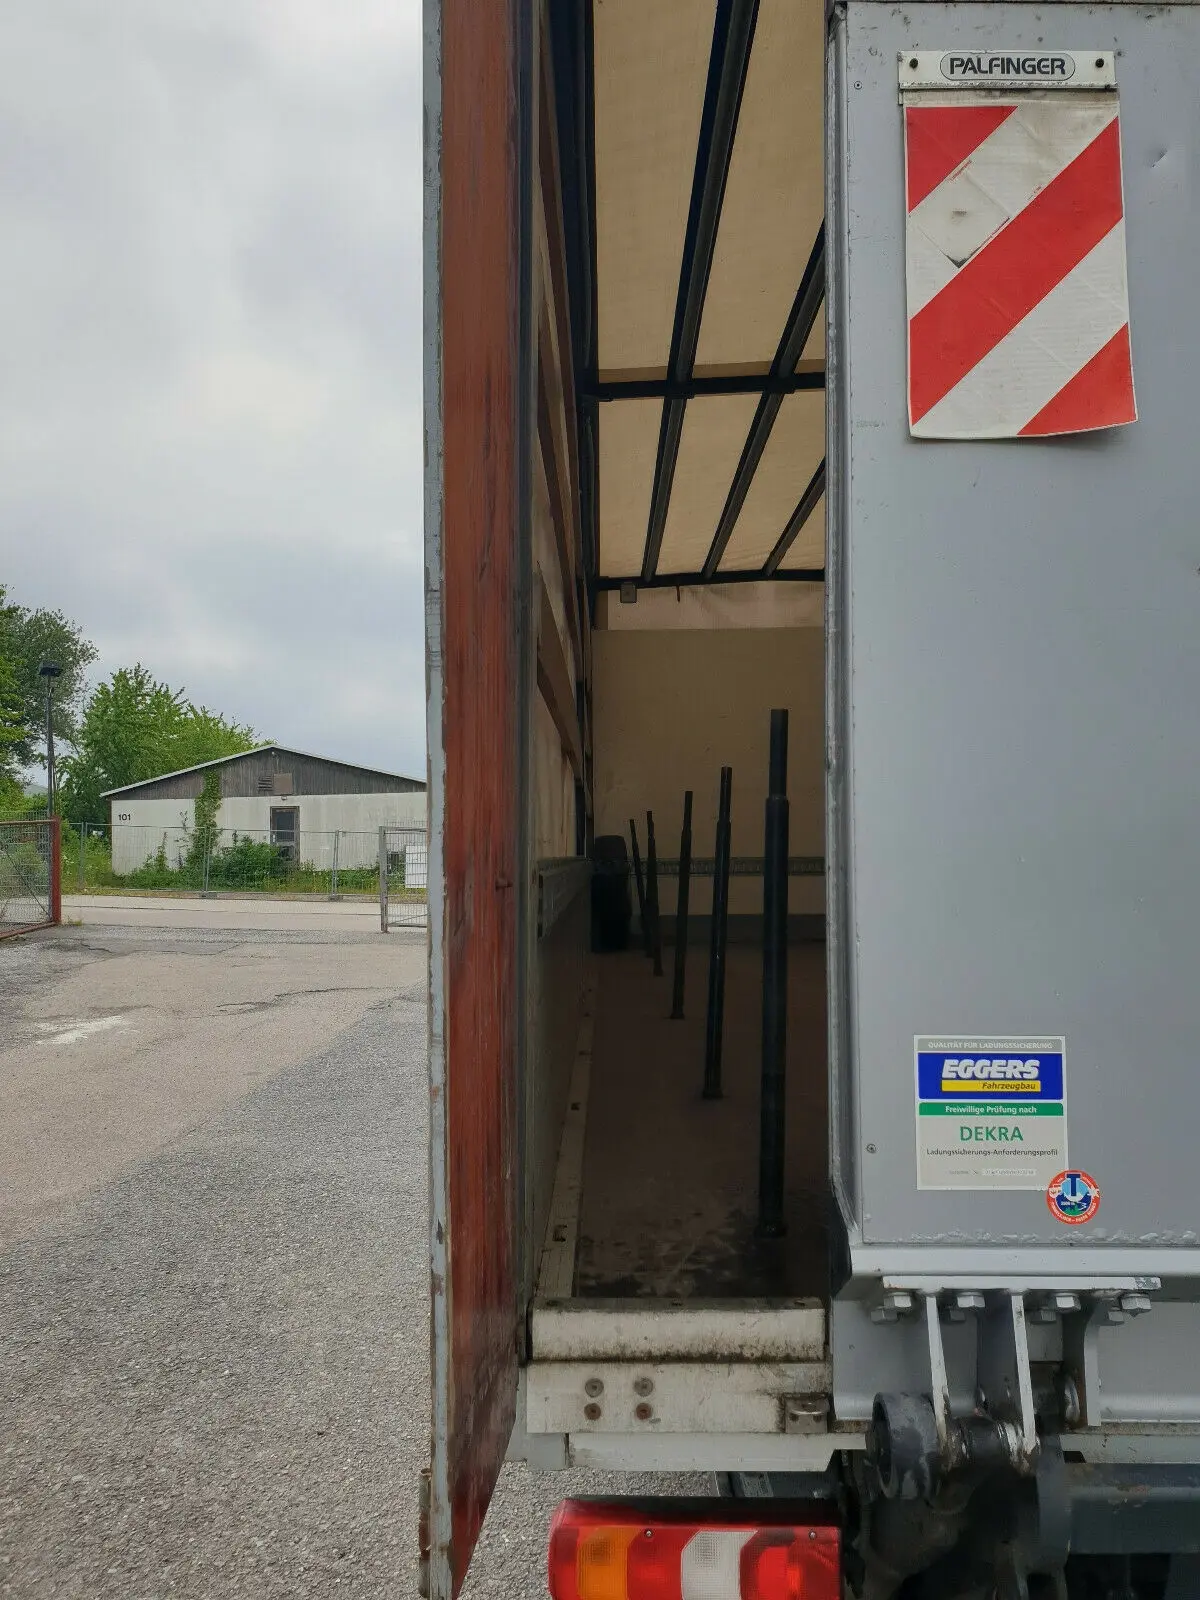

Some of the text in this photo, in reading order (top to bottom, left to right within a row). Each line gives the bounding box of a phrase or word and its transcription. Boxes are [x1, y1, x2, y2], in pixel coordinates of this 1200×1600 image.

[949, 57, 1066, 75] PALFINGER
[118, 813, 131, 821] 101
[927, 1040, 1053, 1050] QUALITÄT FÜR LADUNGSSICHERUNG
[941, 1058, 1041, 1079] EGGERS
[982, 1082, 1036, 1091] Fahrzeugbau
[945, 1105, 1038, 1115] Freiwillige Prüfung nach
[959, 1126, 1024, 1142] DEKRA
[926, 1148, 1058, 1158] Ladungssicherungs-Anforderungsprofil
